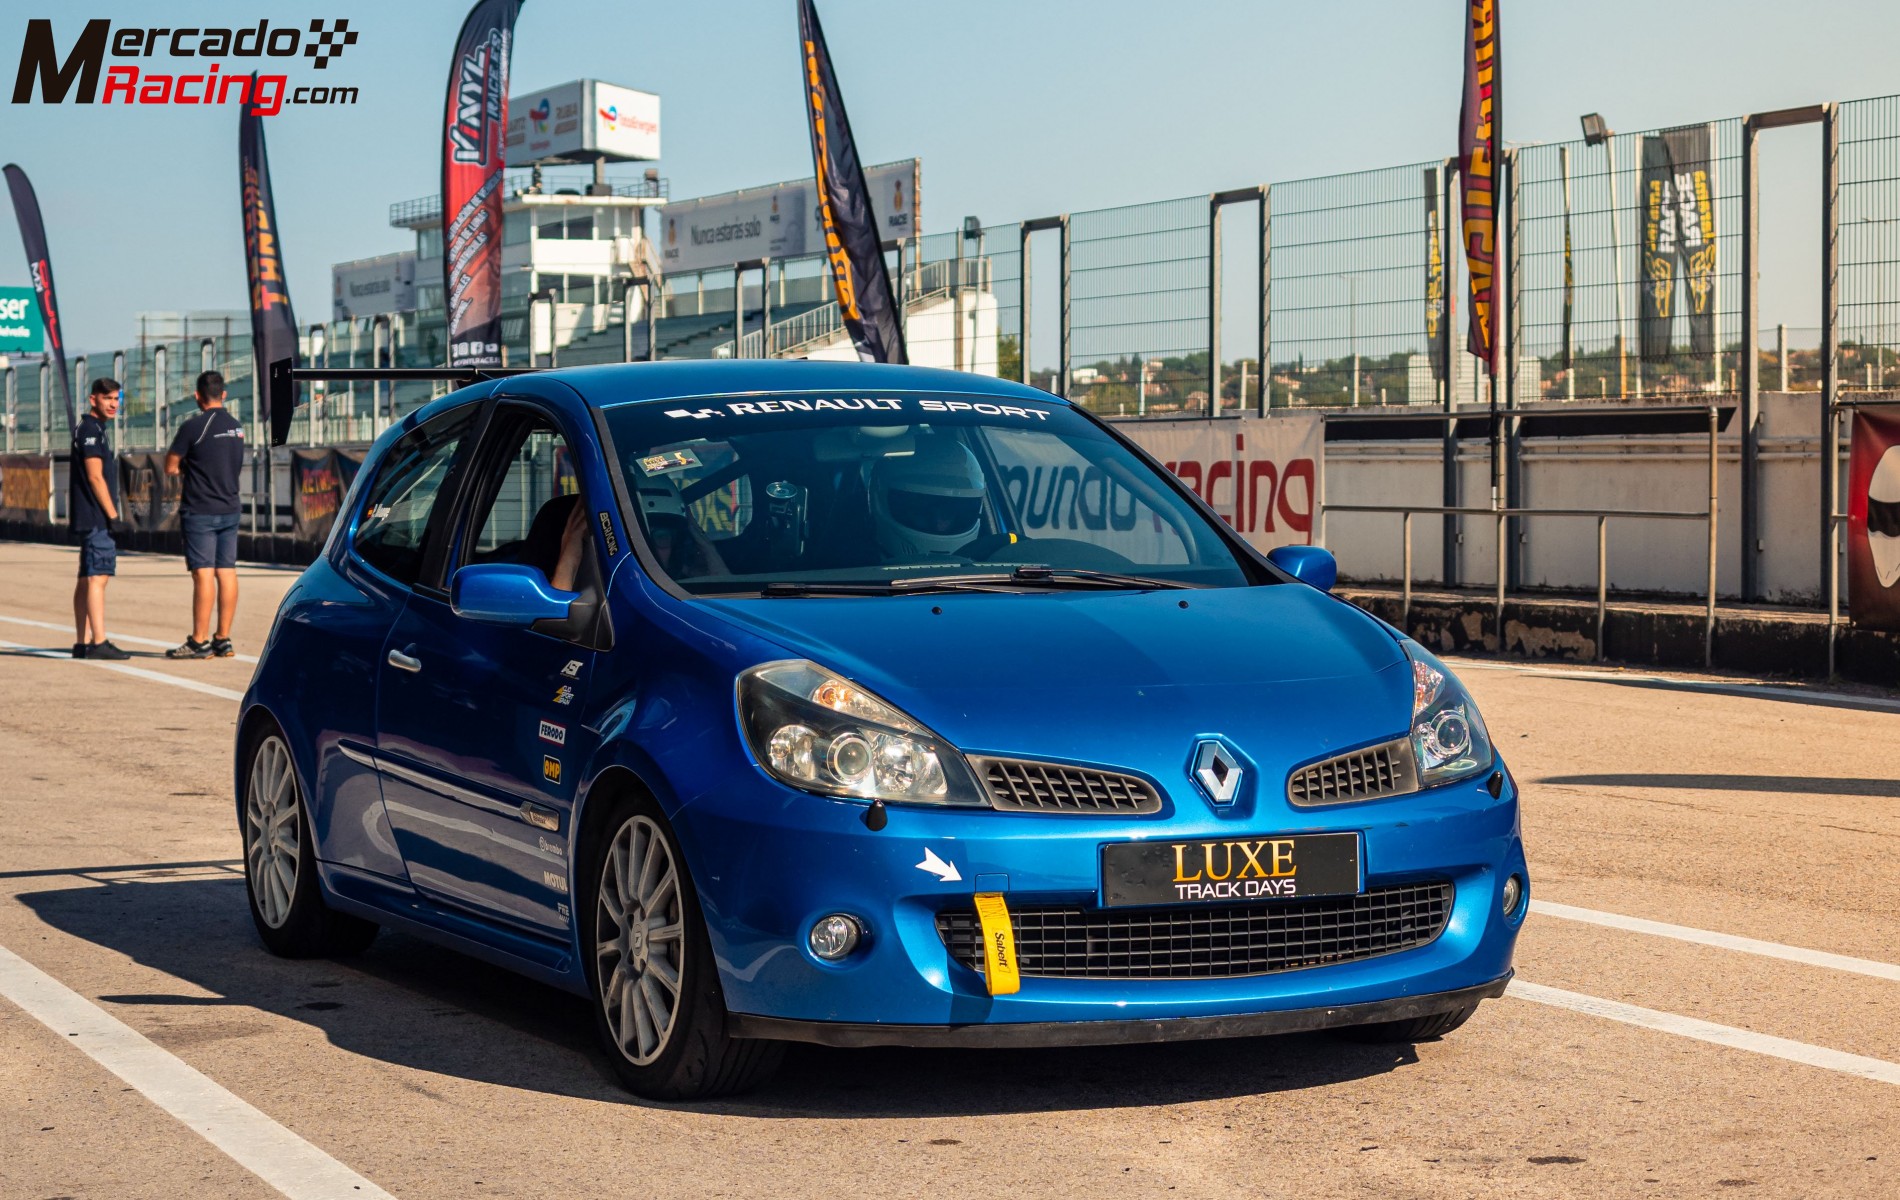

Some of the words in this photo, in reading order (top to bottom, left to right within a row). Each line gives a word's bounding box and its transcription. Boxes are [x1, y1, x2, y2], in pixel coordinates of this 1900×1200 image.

[726, 398, 904, 416] RENAULT
[919, 400, 1051, 421] SPORT
[541, 724, 564, 740] FERODO
[544, 759, 560, 779] OMP
[1171, 839, 1297, 882] LUXE
[543, 870, 569, 892] MOTUL
[1175, 881, 1241, 899] TRACK
[1245, 879, 1297, 897] DAYS
